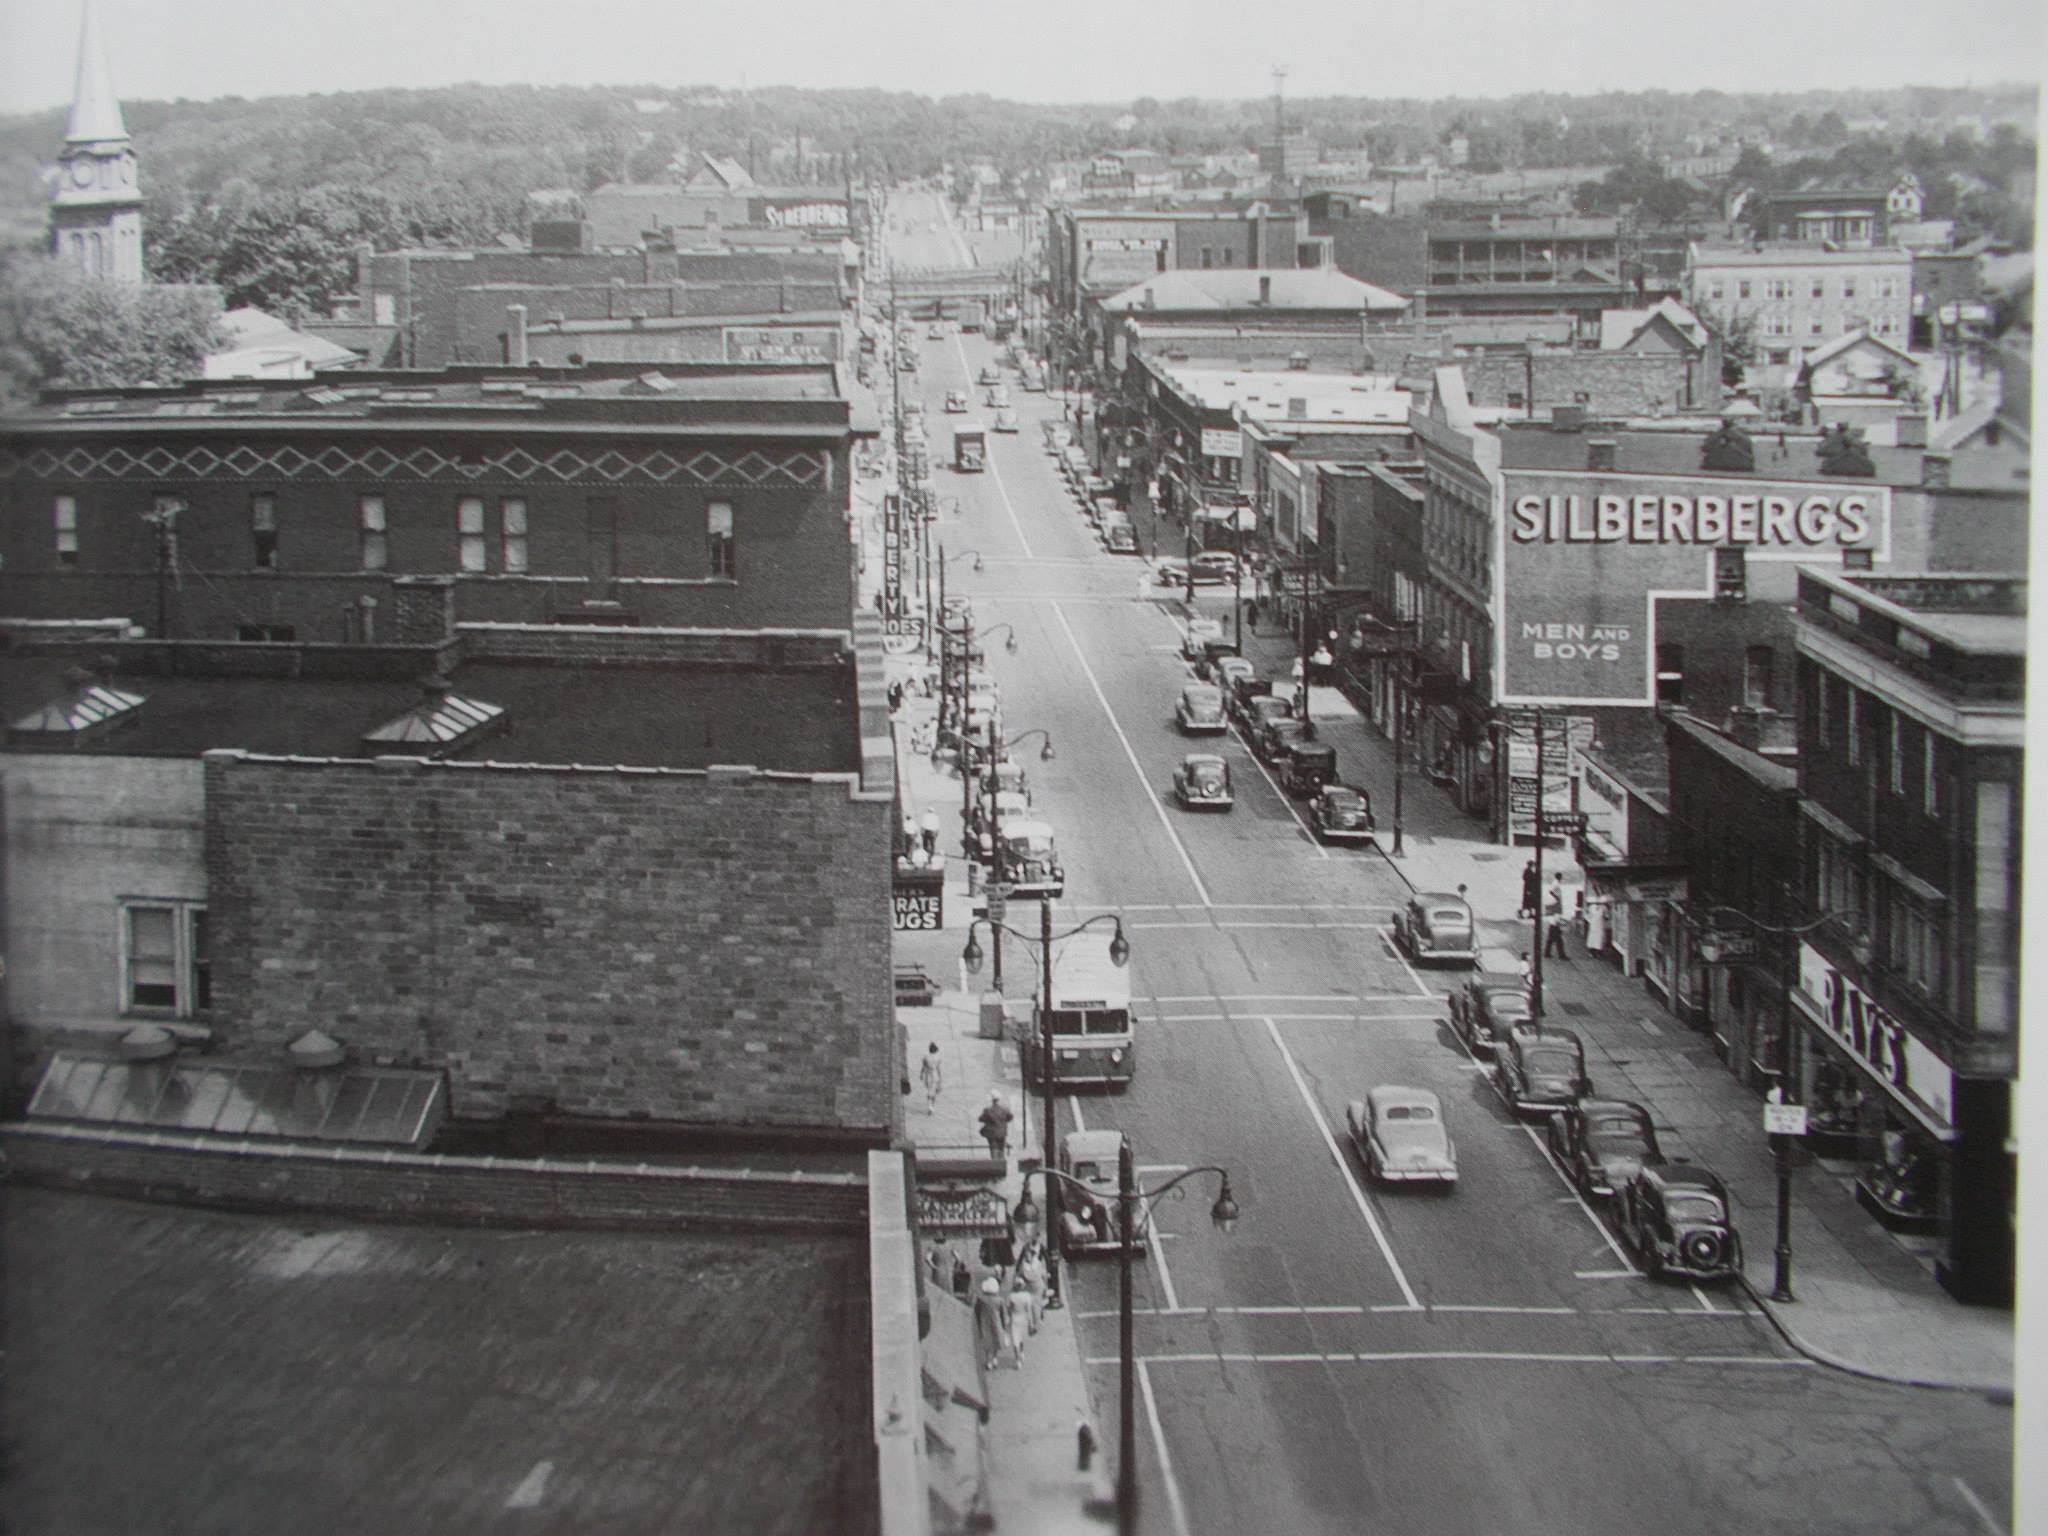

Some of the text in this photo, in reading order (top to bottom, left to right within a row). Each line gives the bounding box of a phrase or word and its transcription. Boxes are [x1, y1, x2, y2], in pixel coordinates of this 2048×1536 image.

[1513, 494, 1870, 546] SILBERBERGS
[886, 499, 899, 614] LIBERTY
[883, 620, 922, 634] OES
[1522, 623, 1630, 641] MEN AND
[1534, 643, 1620, 660] BOYS
